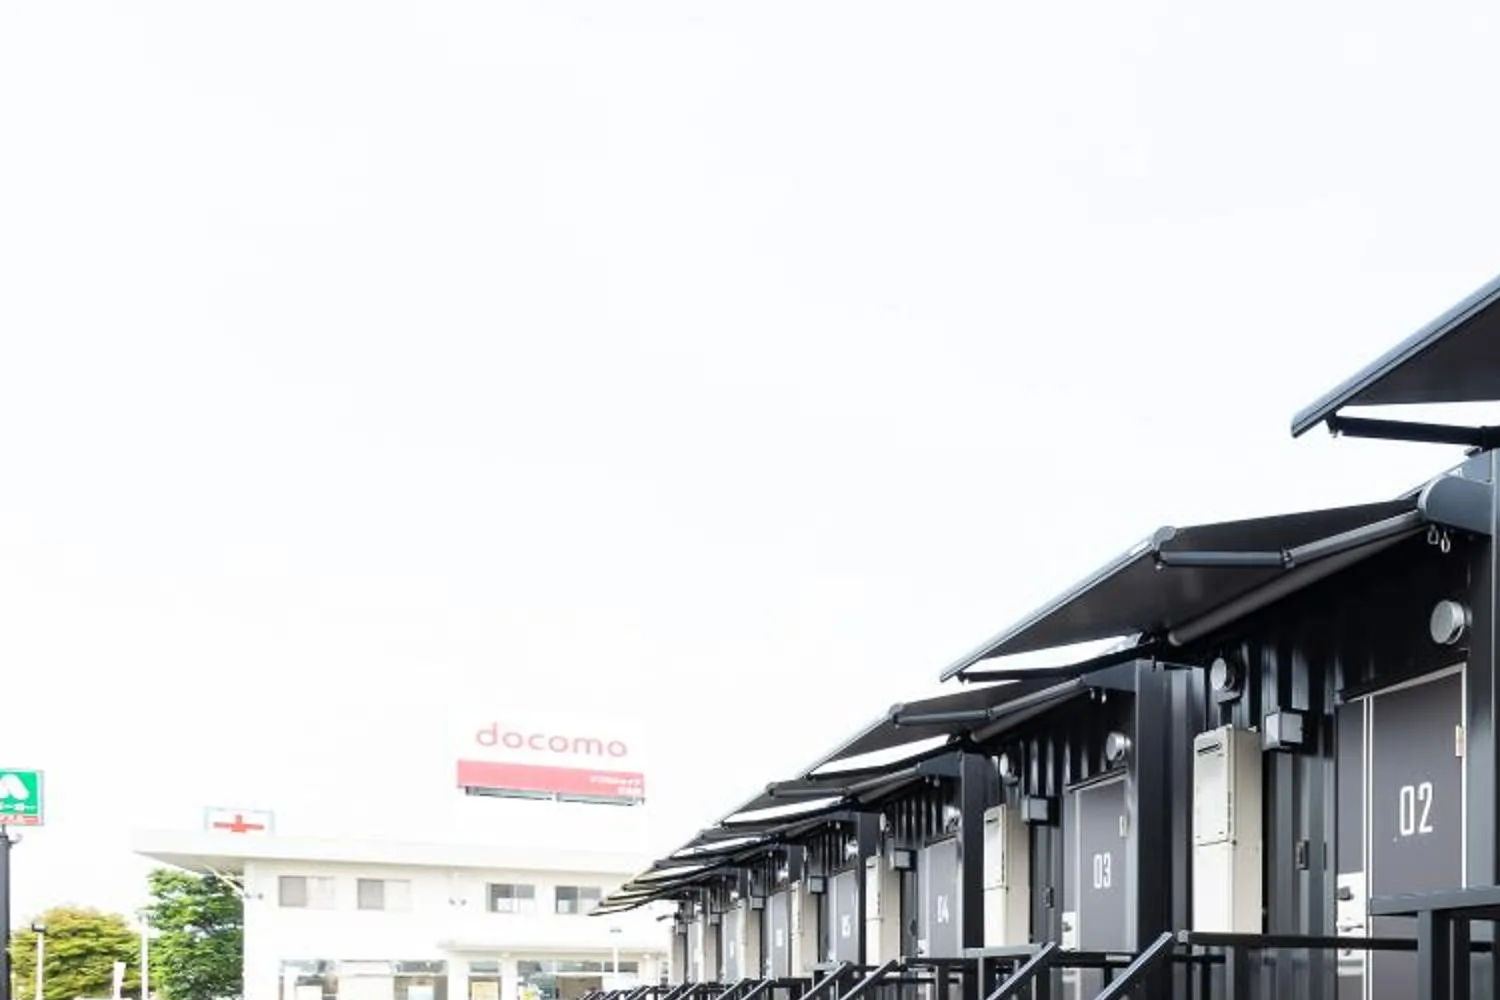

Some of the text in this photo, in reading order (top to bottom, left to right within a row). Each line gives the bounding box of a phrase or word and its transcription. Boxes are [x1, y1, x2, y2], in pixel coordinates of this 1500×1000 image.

[476, 721, 628, 758] docomo
[1400, 781, 1433, 836] 02
[1093, 852, 1111, 889] 03
